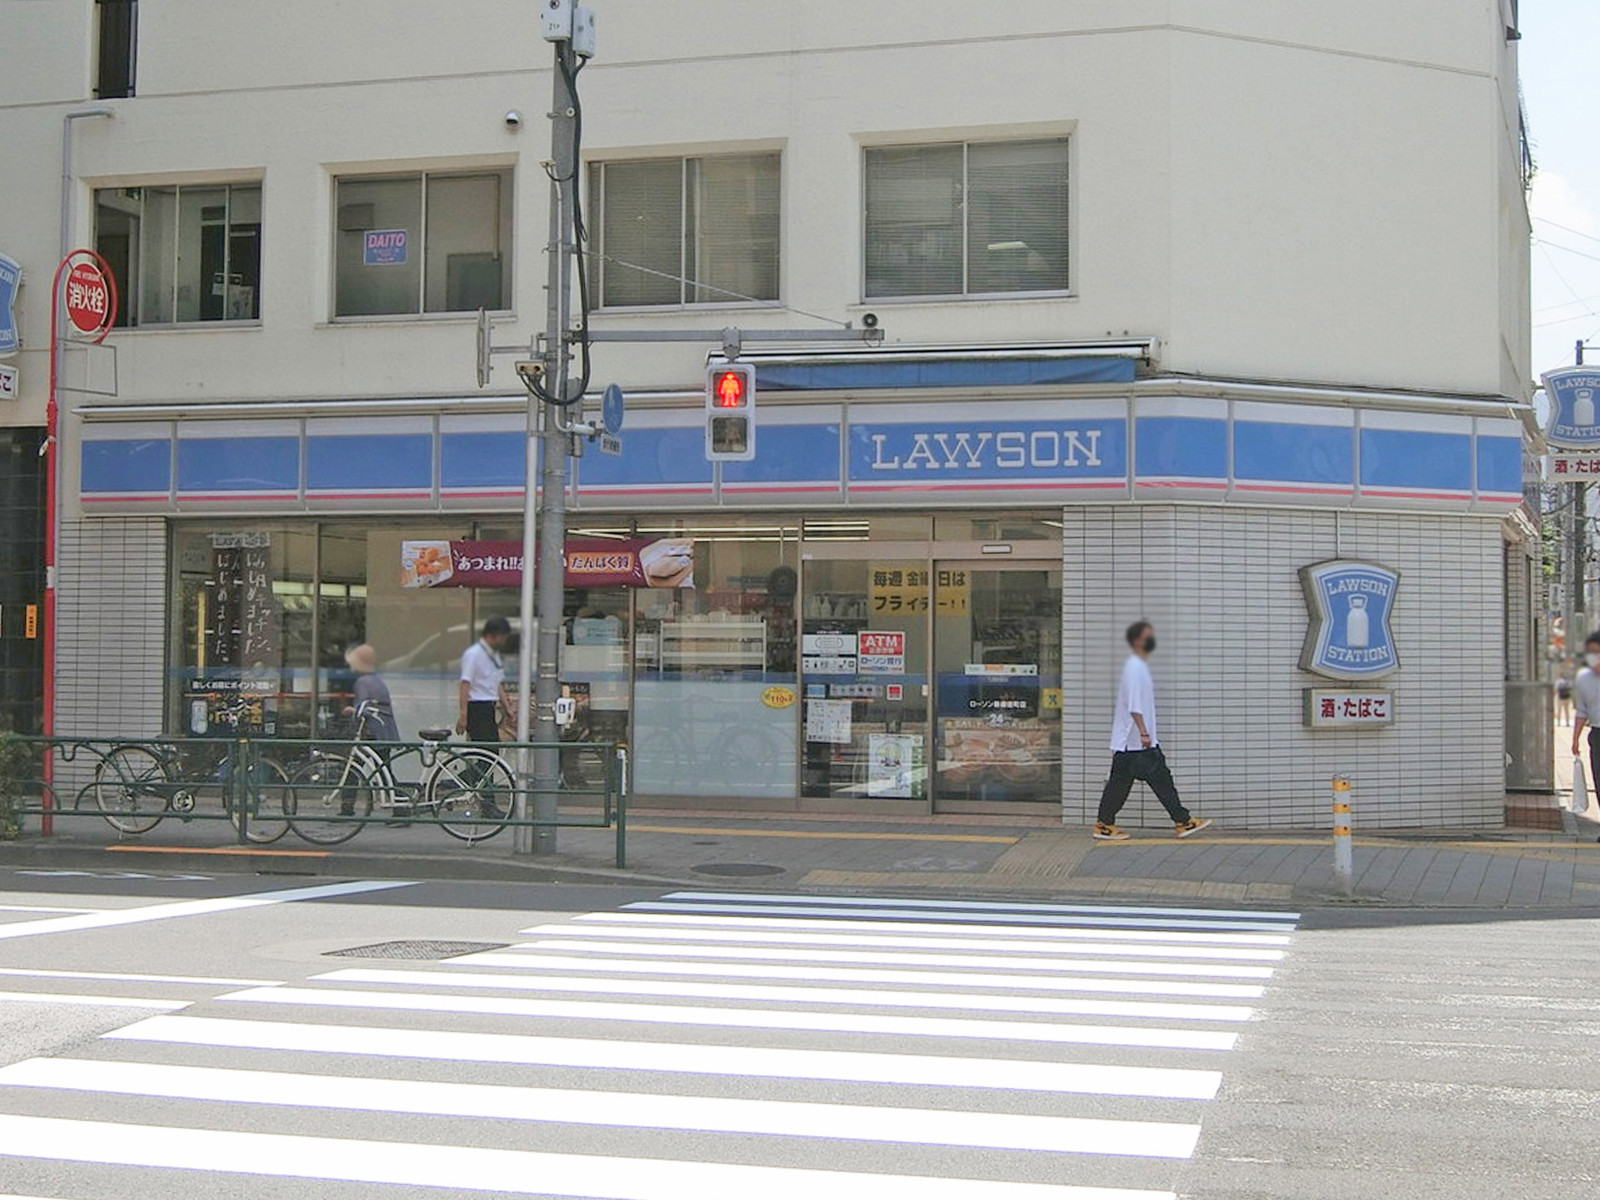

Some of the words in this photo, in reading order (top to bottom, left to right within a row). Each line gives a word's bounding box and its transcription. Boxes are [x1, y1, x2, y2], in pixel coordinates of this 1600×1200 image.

[368, 233, 405, 248] DAITO
[69, 281, 104, 313] 消火栓
[871, 430, 1102, 470] LAWSON
[1327, 578, 1388, 597] LAWSON
[865, 636, 897, 647] ATM
[1327, 645, 1388, 662] STATION
[1321, 698, 1386, 718] 酒・たばこ
